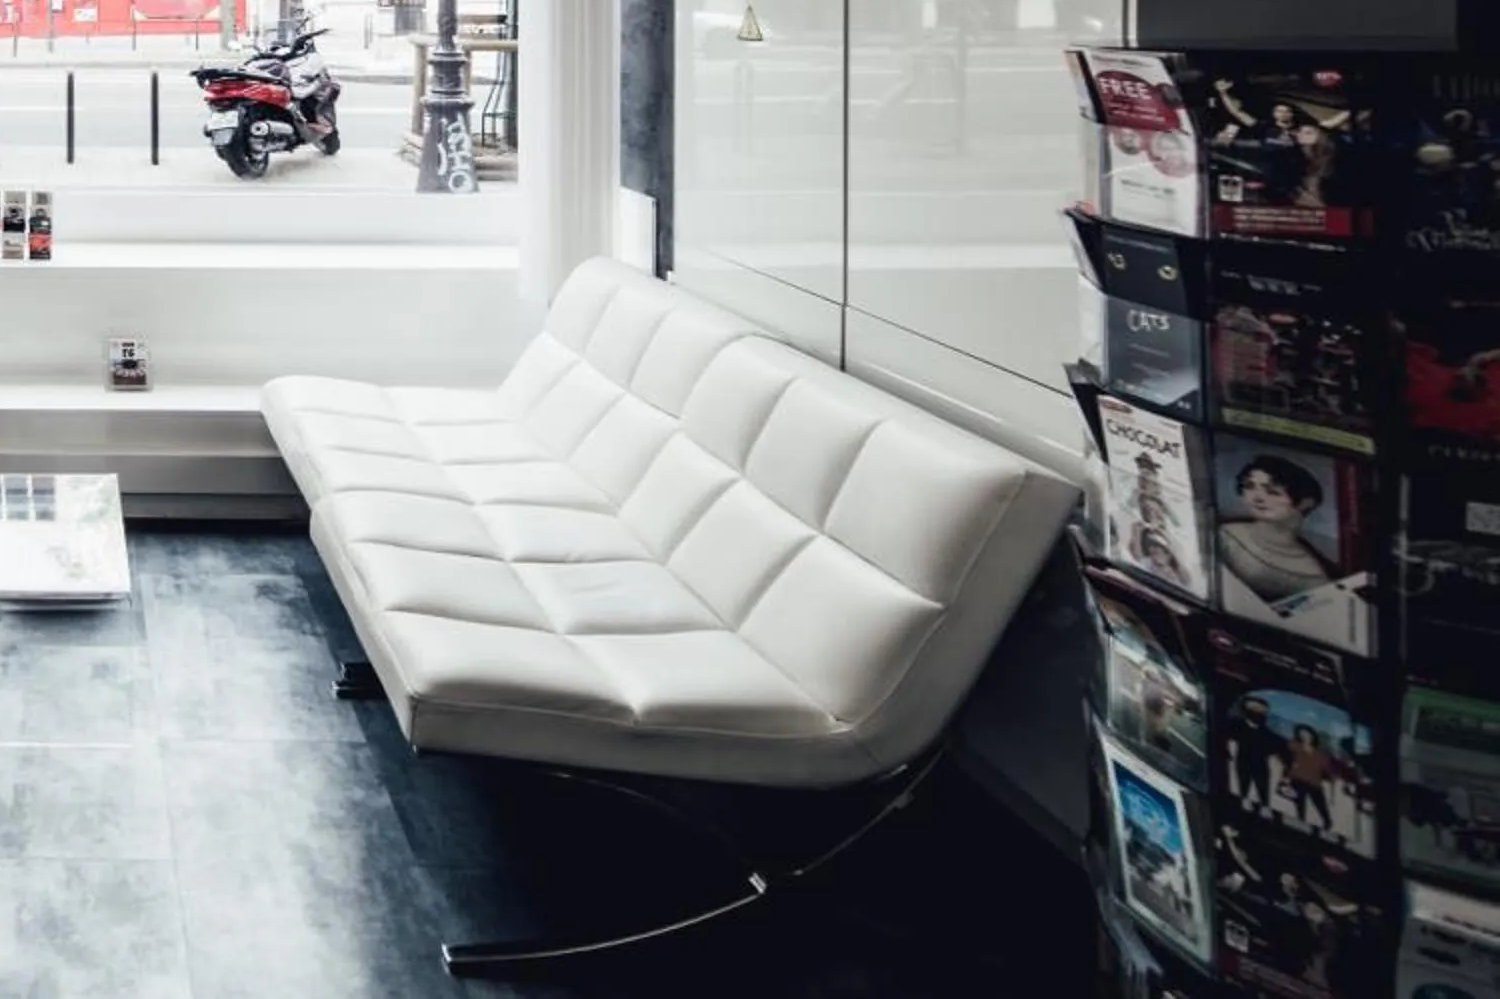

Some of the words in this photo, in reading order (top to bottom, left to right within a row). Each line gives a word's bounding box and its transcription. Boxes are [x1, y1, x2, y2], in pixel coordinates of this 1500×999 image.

[1099, 77, 1153, 101] FREE
[1126, 308, 1171, 332] CATS
[1106, 418, 1181, 458] CHOCOLAT
